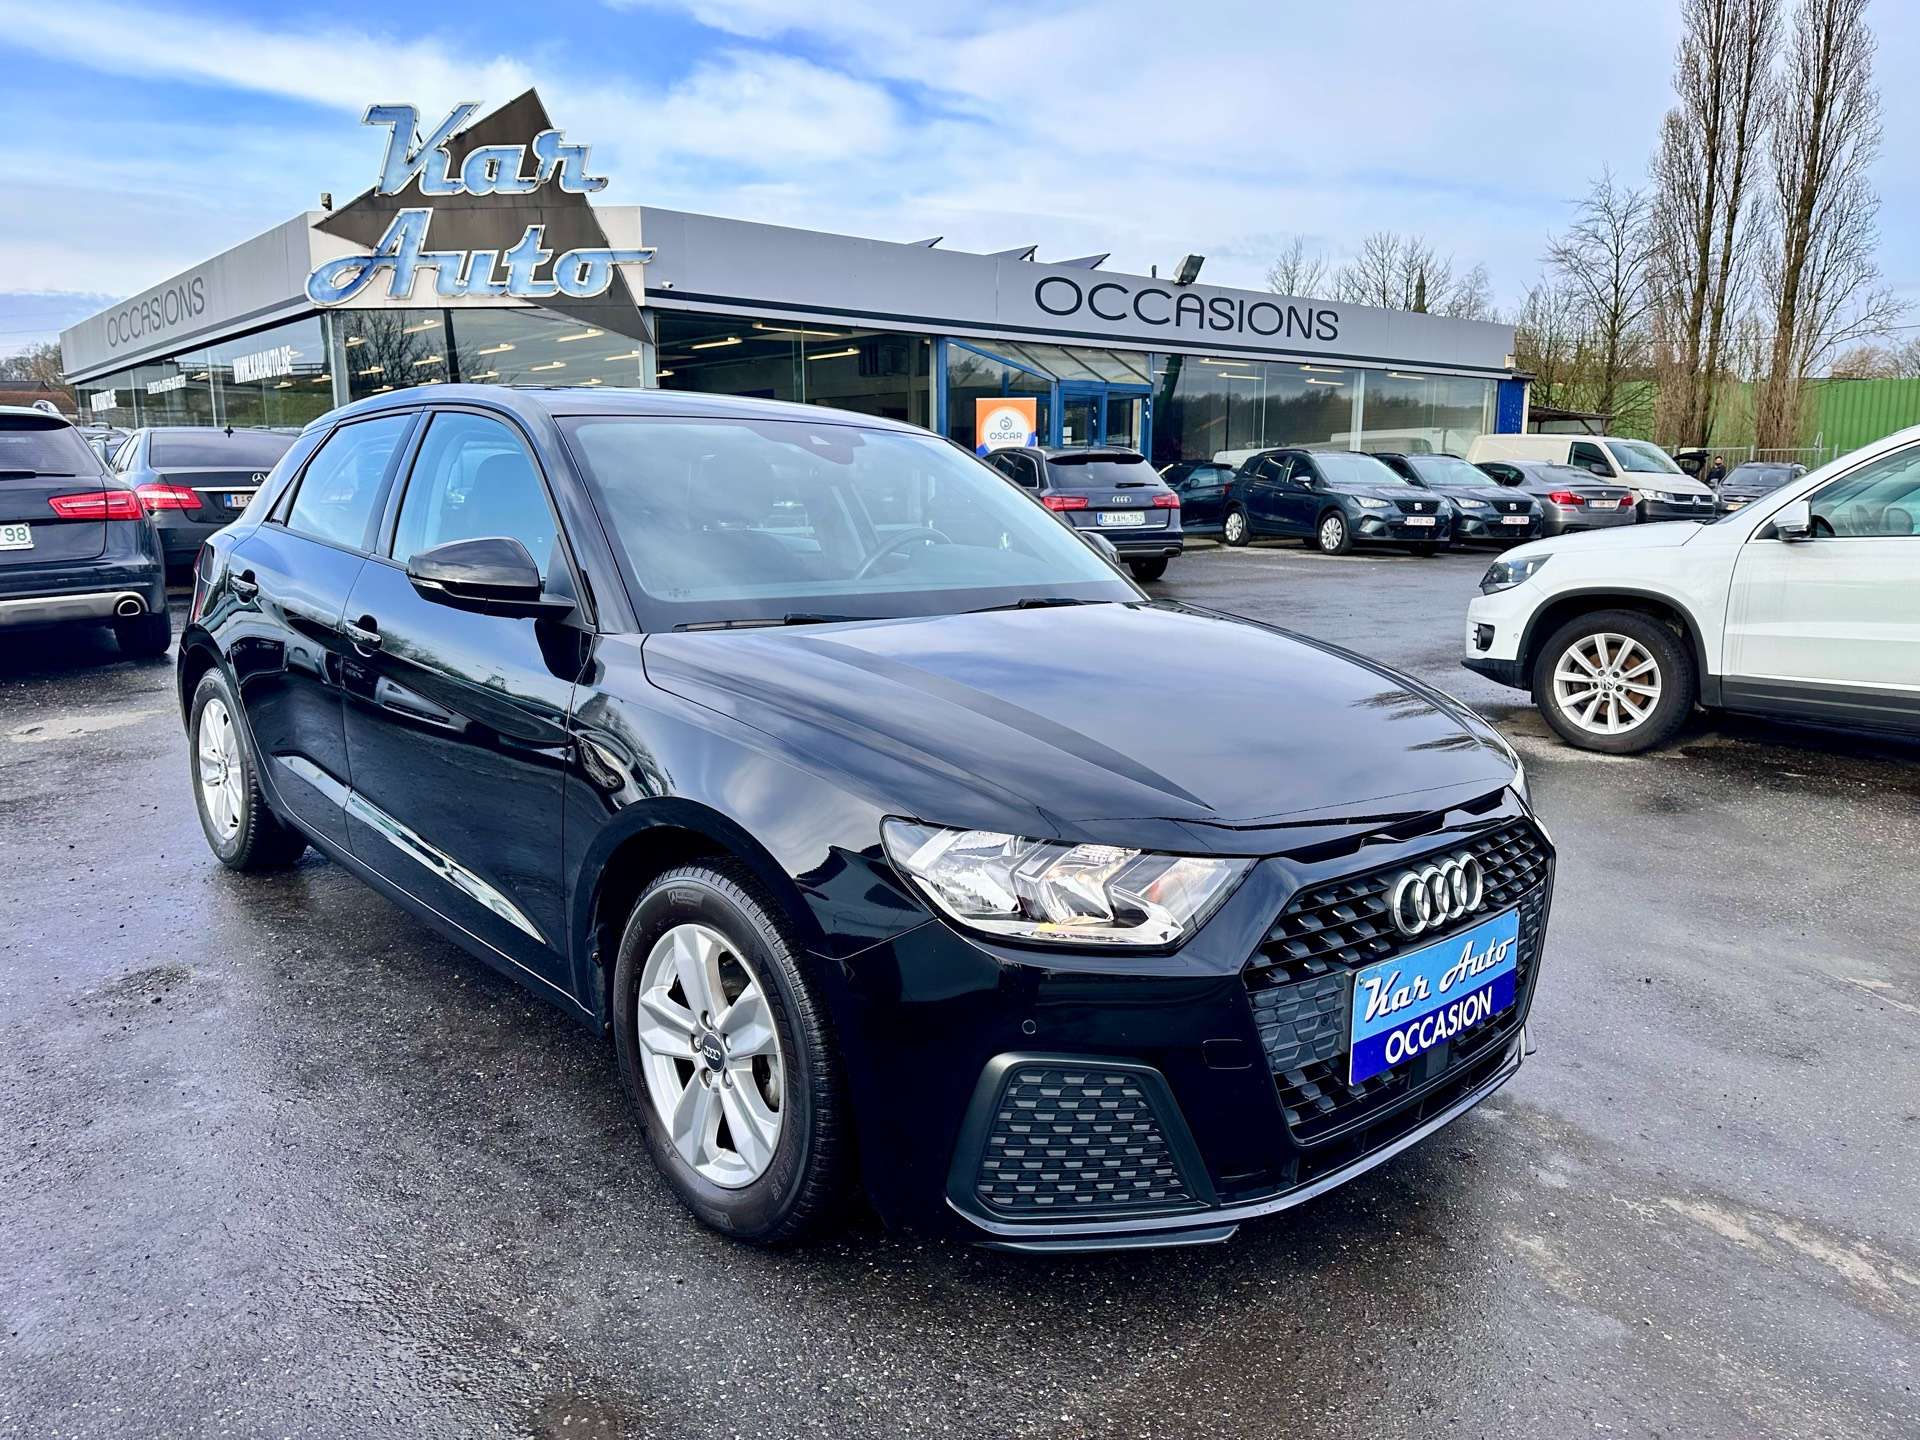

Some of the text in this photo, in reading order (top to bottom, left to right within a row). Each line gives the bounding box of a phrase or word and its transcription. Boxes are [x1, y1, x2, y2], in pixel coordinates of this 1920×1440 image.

[361, 100, 609, 197] Kar
[304, 207, 658, 306] Auto
[106, 276, 206, 348] OCCASIONS
[1034, 276, 1340, 342] OCCASIONS
[989, 431, 1023, 441] OSCAR
[0, 526, 28, 542] 98
[1363, 935, 1516, 1022] Kar Auto
[1384, 985, 1494, 1065] OCCASION
